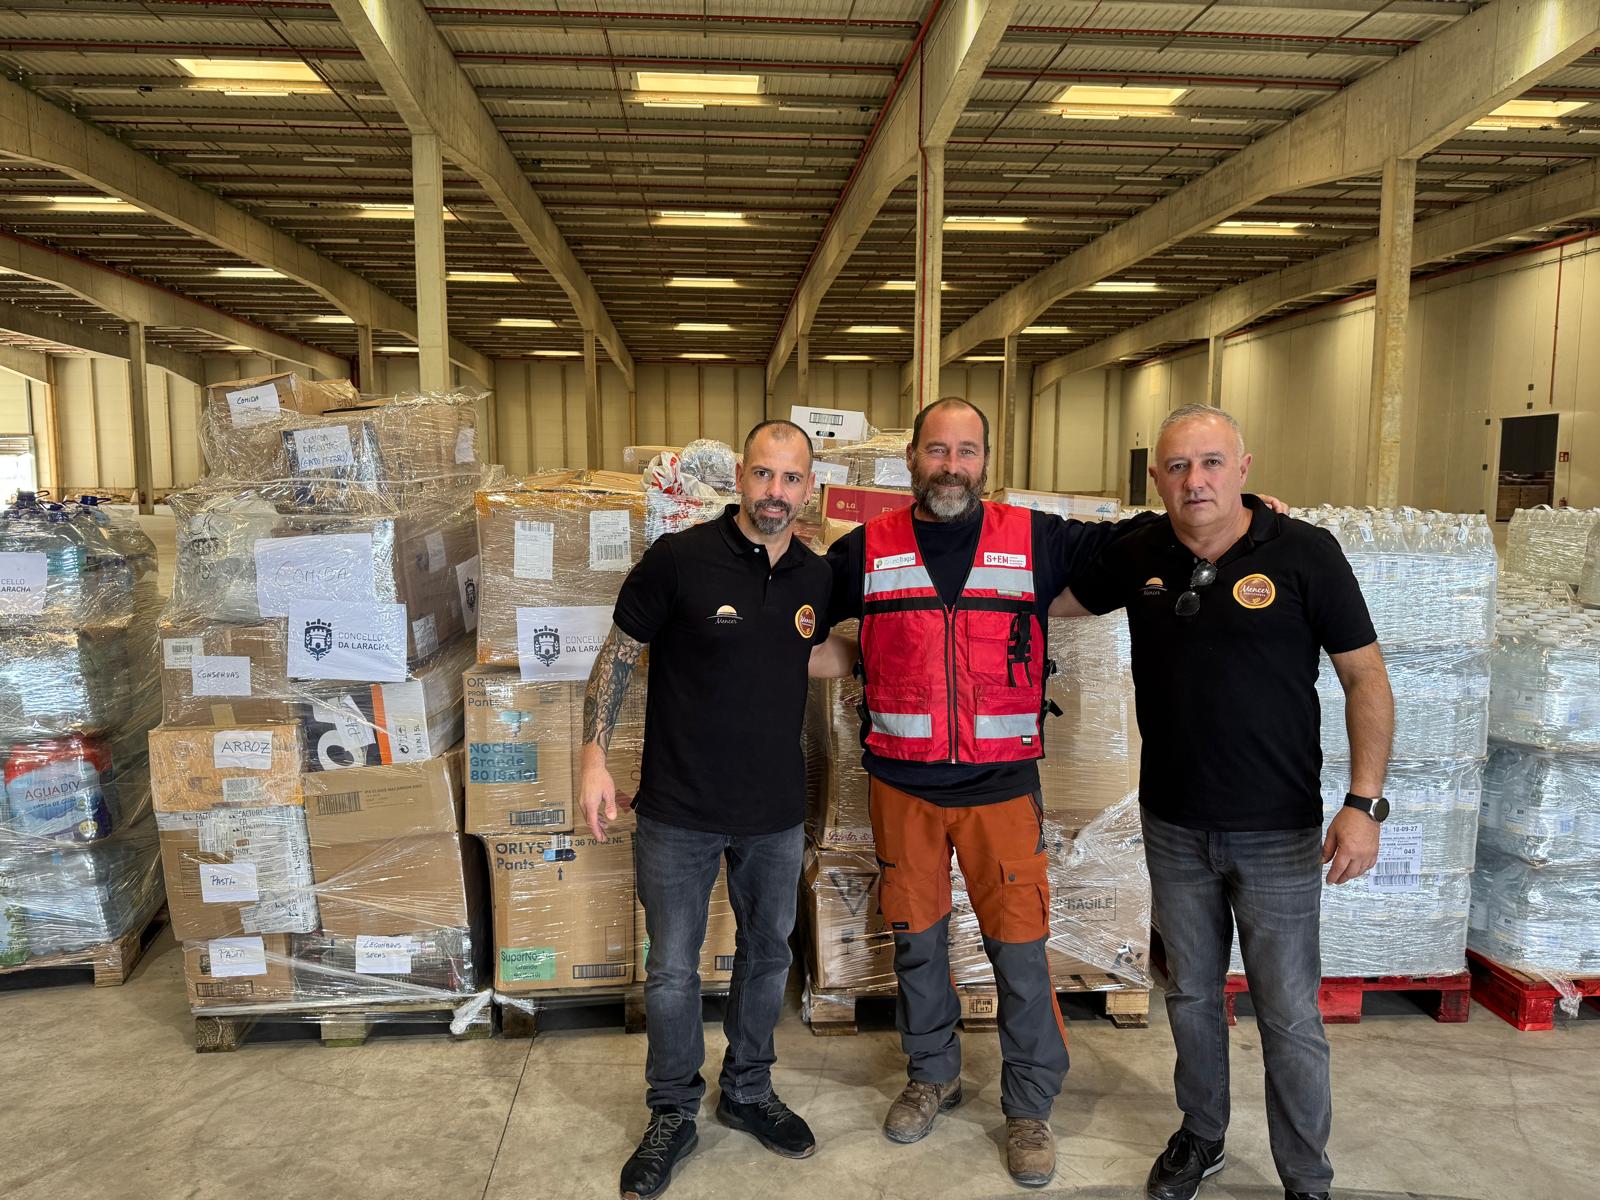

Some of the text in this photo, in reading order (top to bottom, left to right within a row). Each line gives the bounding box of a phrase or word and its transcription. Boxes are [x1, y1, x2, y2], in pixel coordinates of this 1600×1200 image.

[236, 395, 259, 404] COMIDA
[274, 560, 347, 587] COMIDA
[1239, 584, 1270, 594] Mencer
[338, 631, 383, 642] CONCELLO
[338, 641, 390, 651] DA LARACHA
[565, 643, 603, 653] DA LARAC
[197, 668, 241, 679] CONSERVAS
[221, 740, 272, 754] ARROZ
[470, 742, 524, 754] NOCHE
[471, 769, 490, 781] 80
[495, 842, 544, 855] ORLYS
[496, 858, 535, 871] Pants
